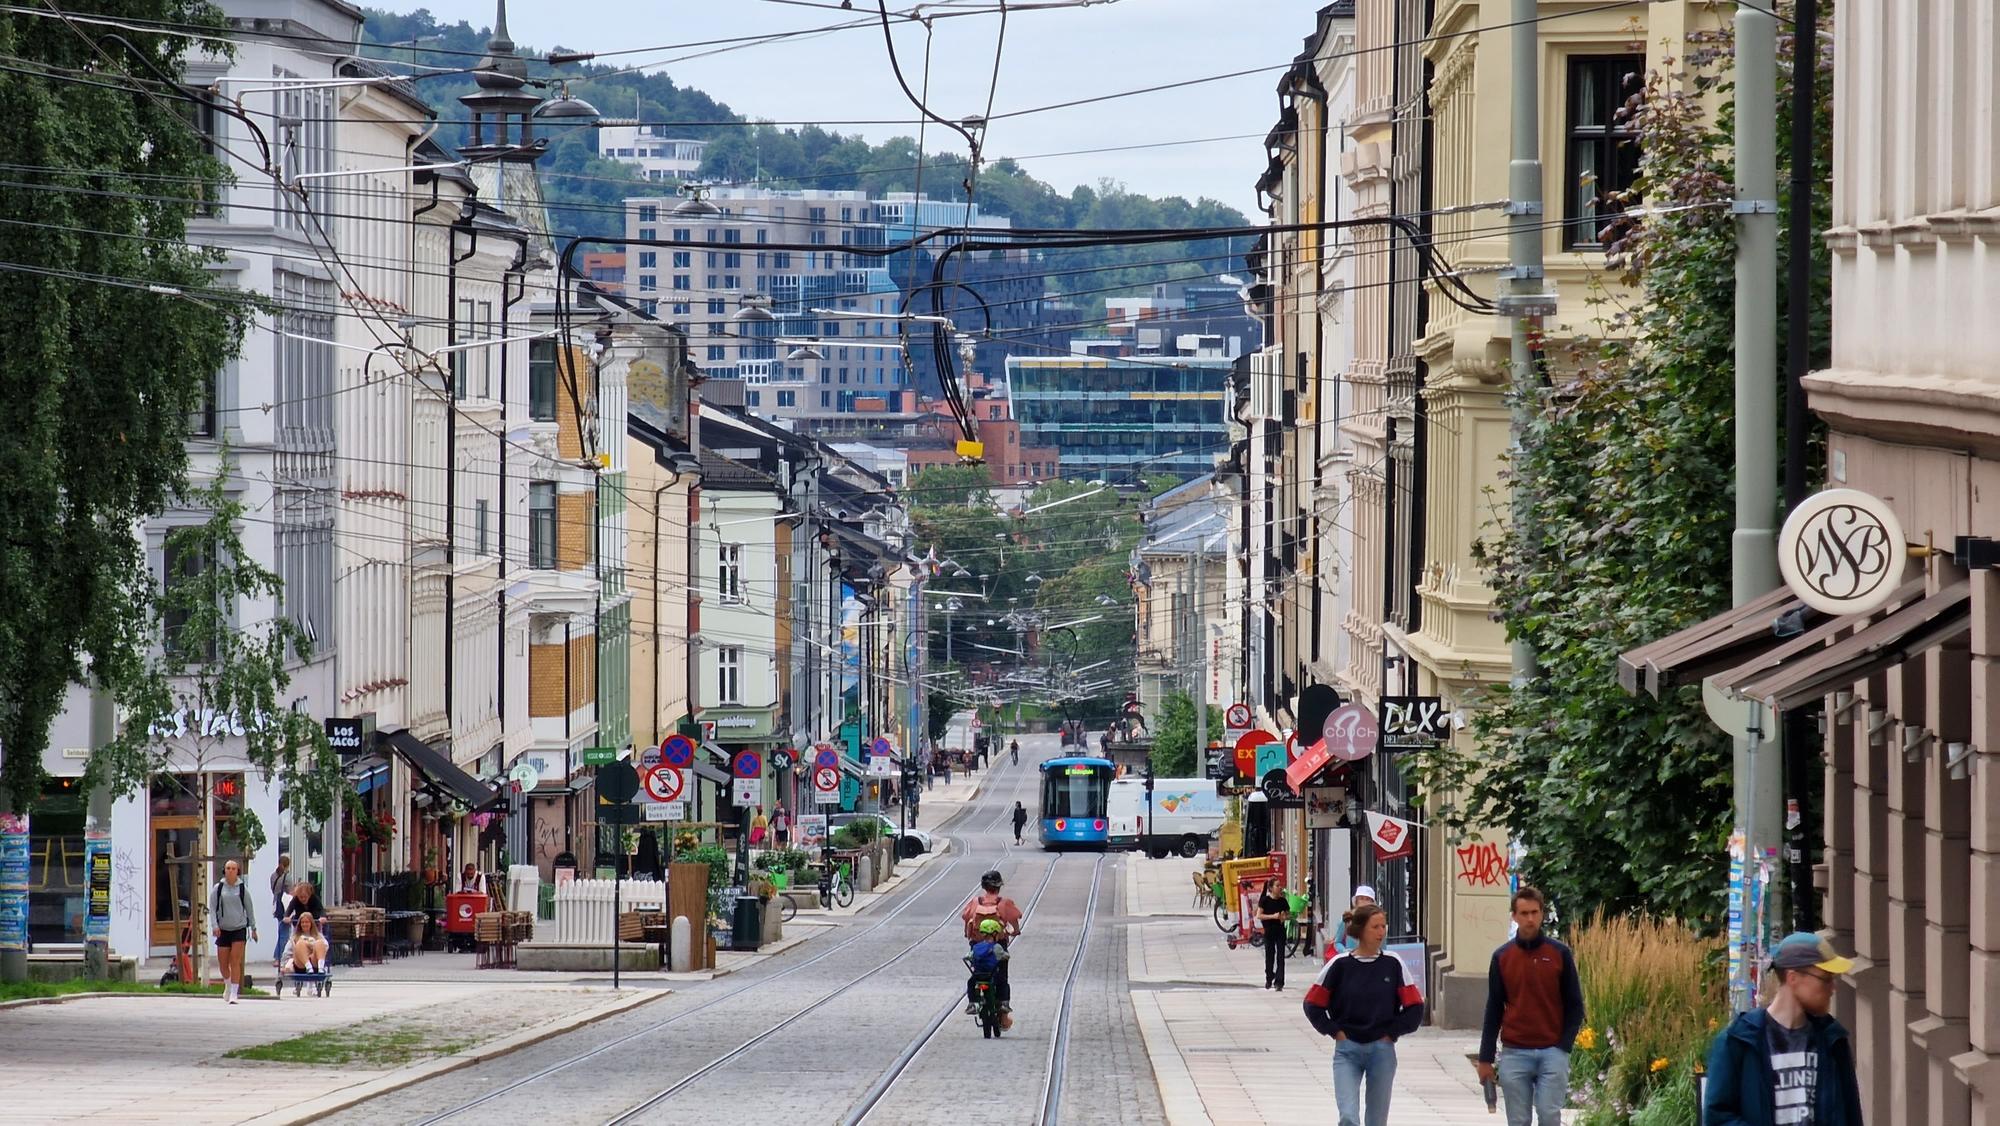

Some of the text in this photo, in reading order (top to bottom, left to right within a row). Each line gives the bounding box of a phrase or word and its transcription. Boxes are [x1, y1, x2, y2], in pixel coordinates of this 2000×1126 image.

[1384, 702, 1438, 734] DLX
[334, 726, 353, 737] LOS
[328, 736, 360, 748] TACOS
[774, 754, 789, 769] SX
